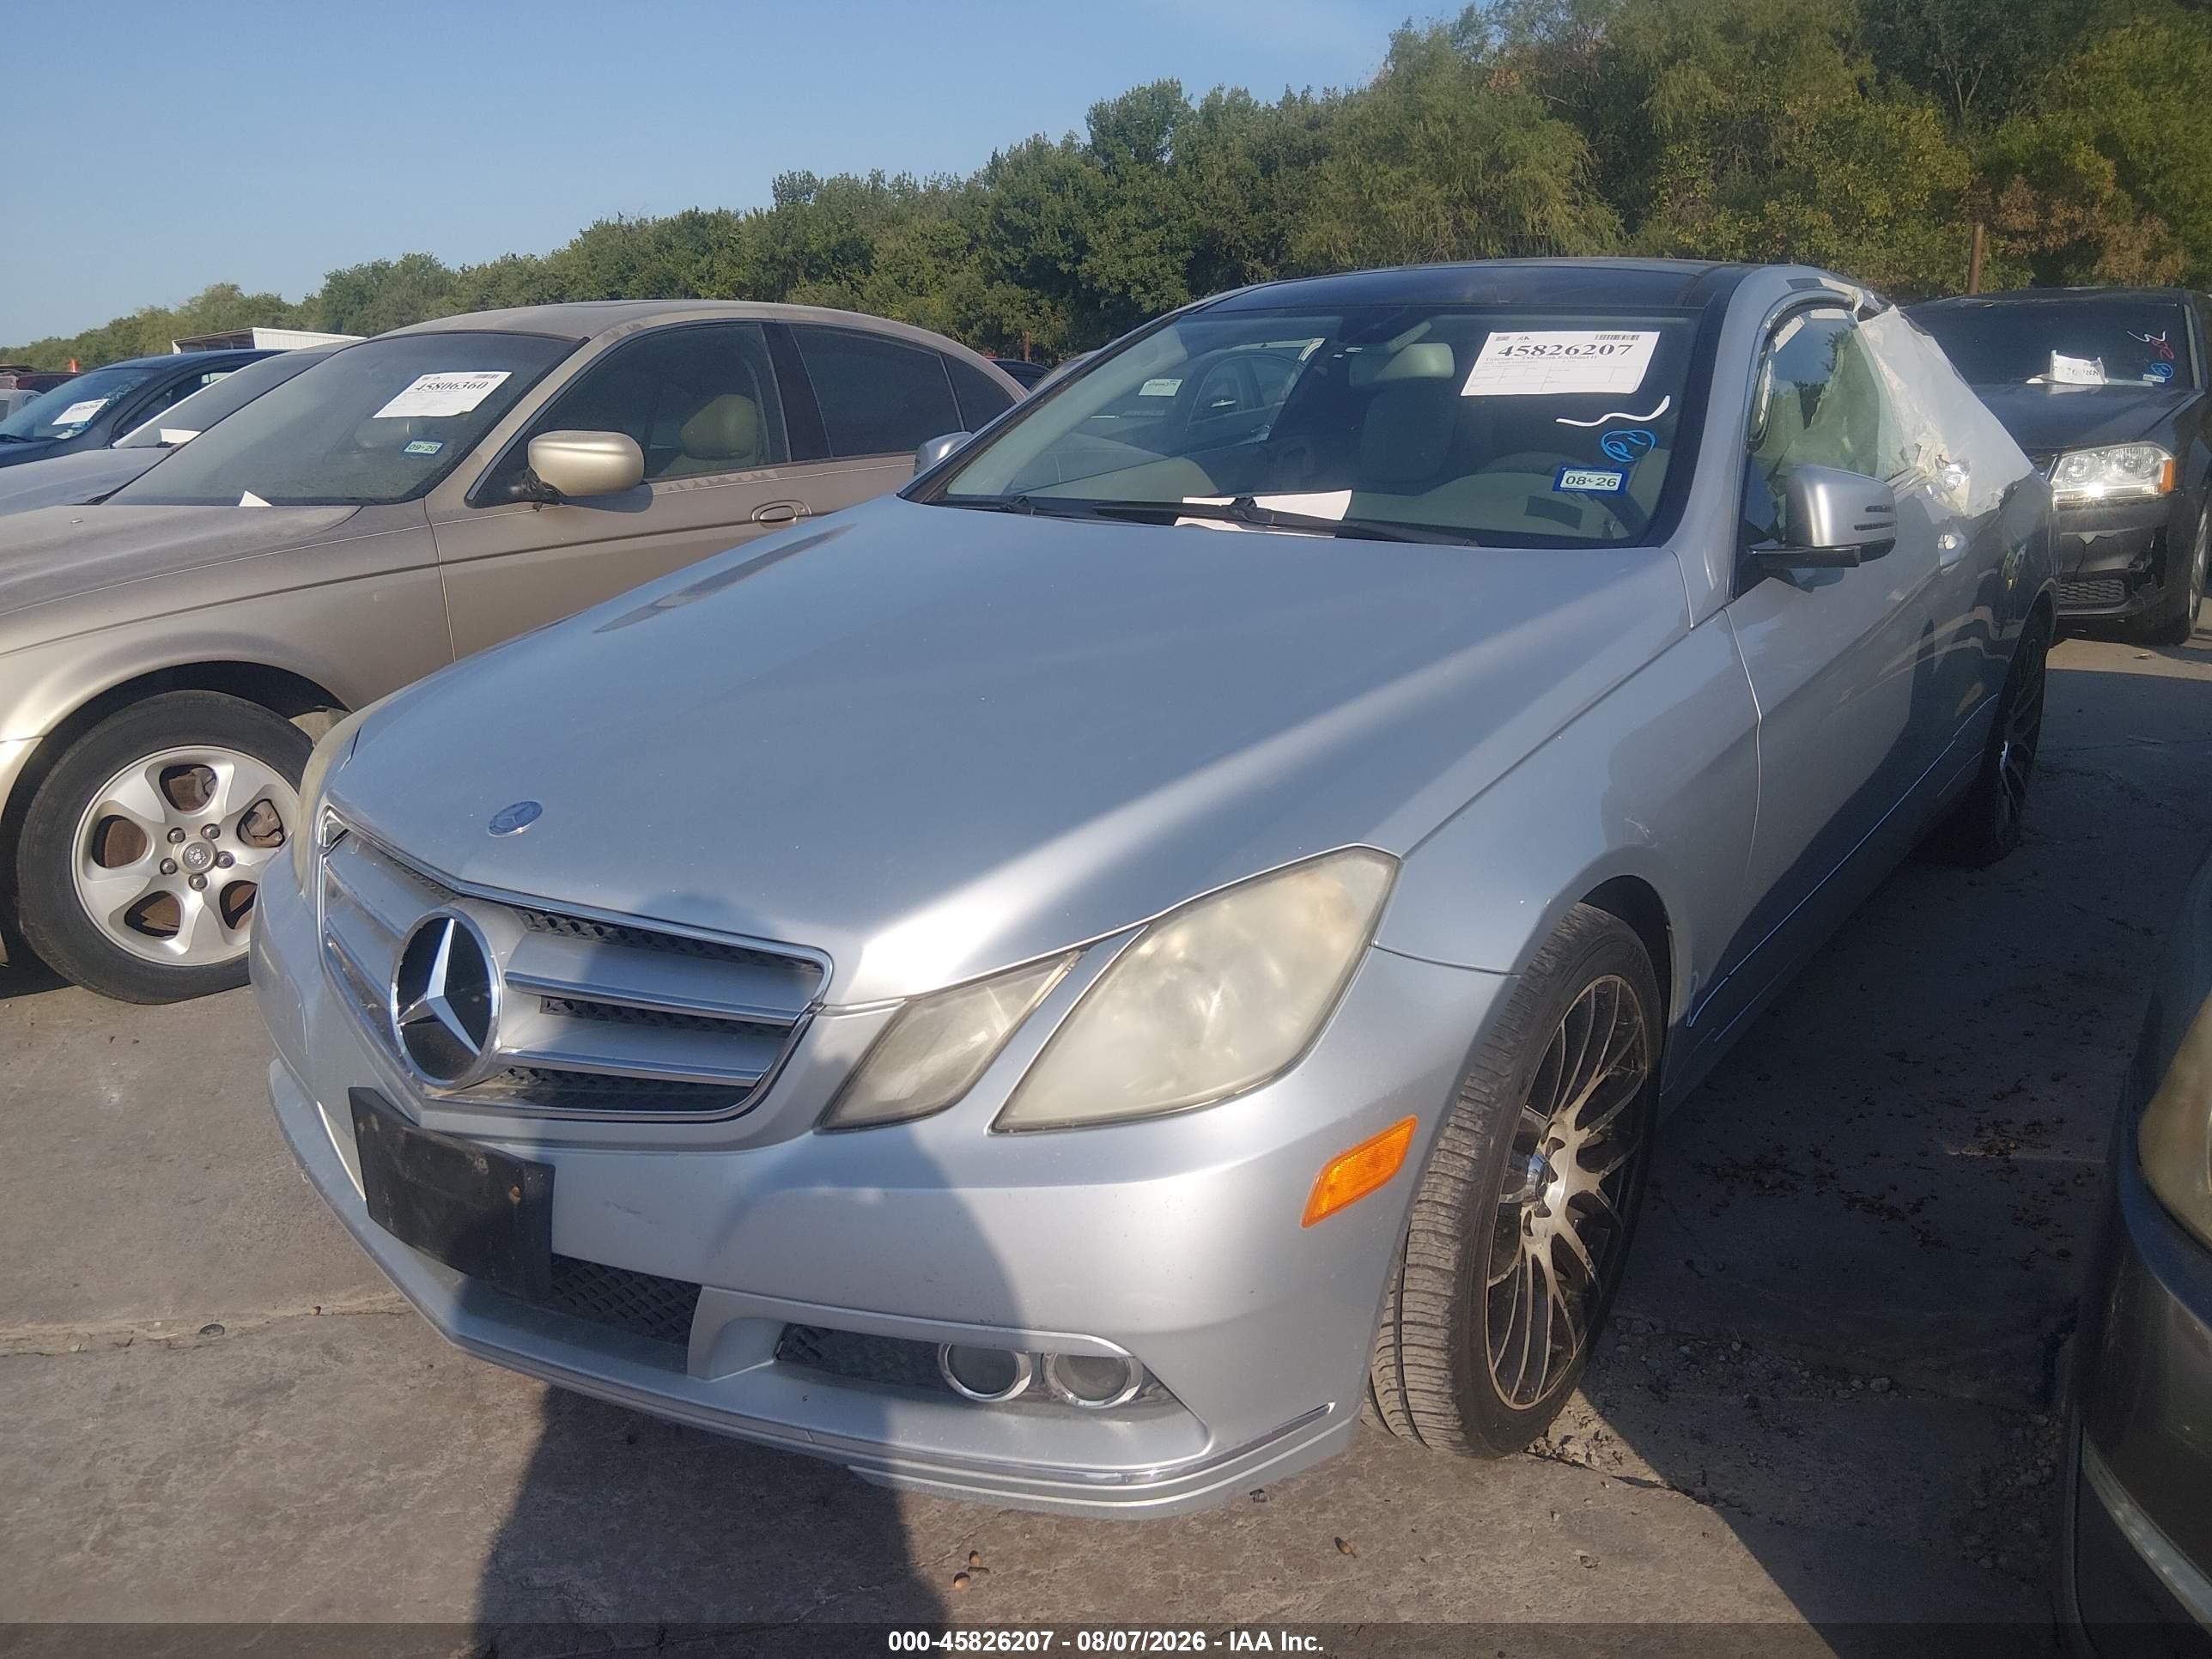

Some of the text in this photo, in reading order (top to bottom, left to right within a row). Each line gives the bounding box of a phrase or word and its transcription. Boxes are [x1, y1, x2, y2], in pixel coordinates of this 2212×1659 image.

[1498, 344, 1634, 356] 45826207
[415, 381, 489, 392] 45806360
[1565, 476, 1618, 487] 08 26
